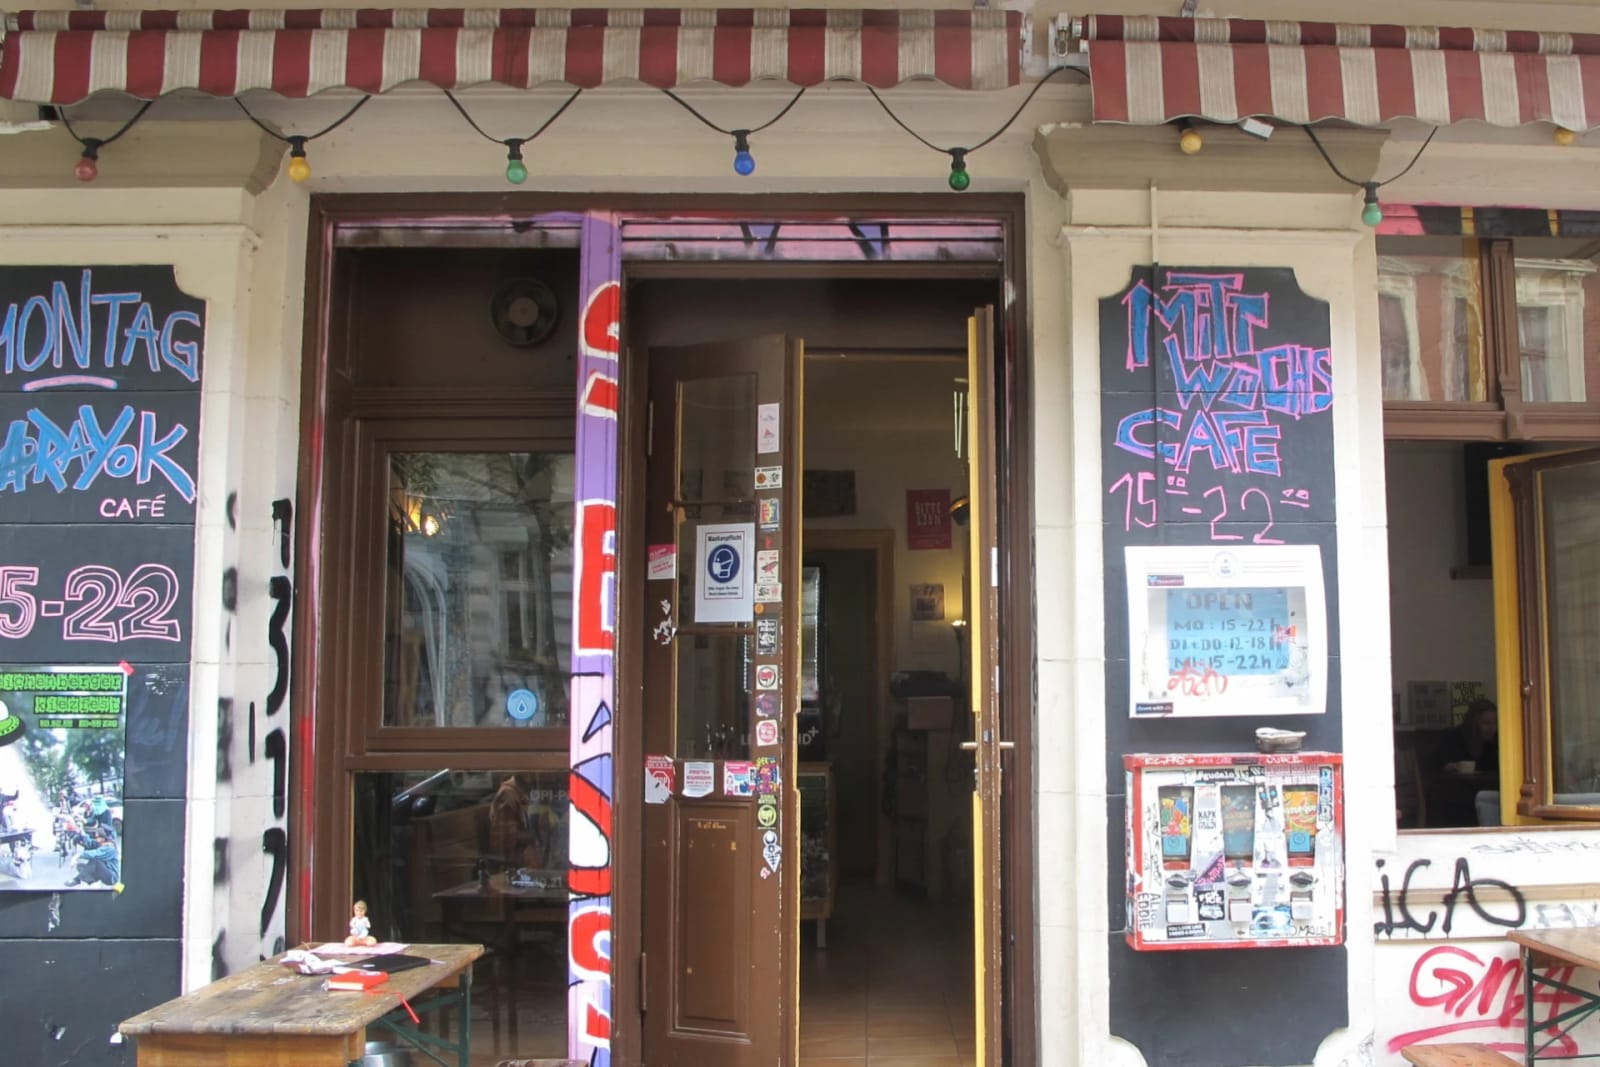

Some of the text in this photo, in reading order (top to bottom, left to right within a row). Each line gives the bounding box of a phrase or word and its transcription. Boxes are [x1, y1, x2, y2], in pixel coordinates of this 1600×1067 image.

[99, 493, 166, 518] CAFÉ
[1186, 592, 1254, 611] OPEN
[35, 697, 120, 712] kiezfest
